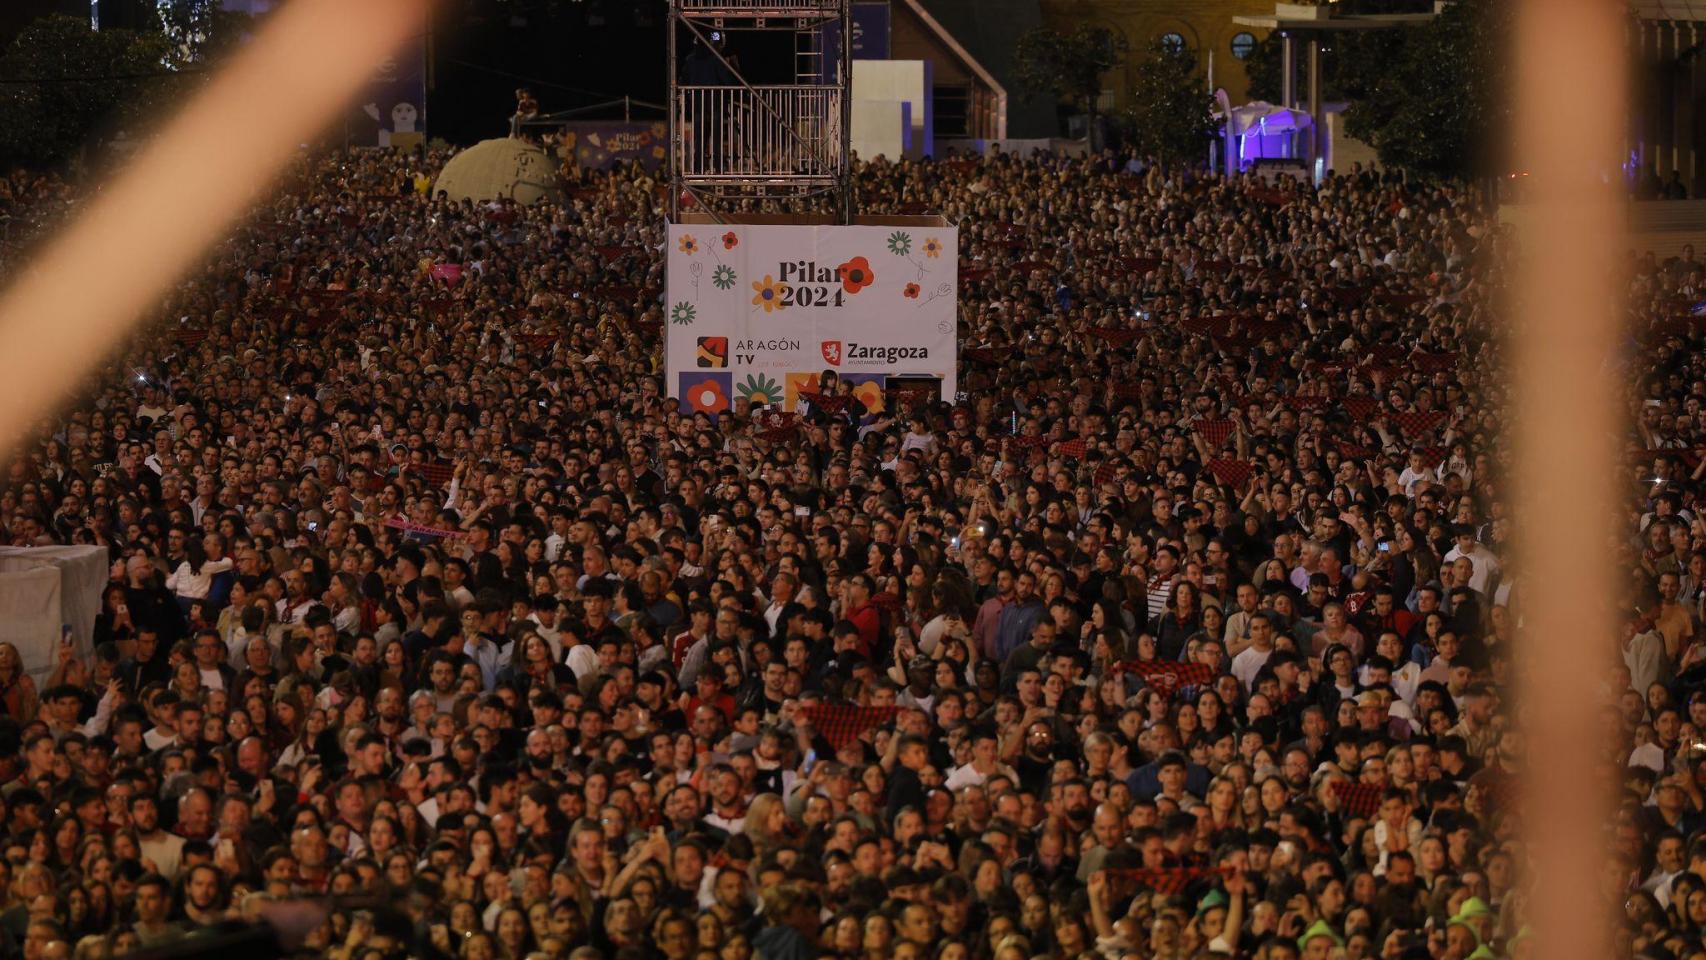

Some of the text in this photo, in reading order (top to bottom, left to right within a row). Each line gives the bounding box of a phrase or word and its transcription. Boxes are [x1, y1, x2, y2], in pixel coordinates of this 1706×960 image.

[779, 260, 848, 283] Pilar
[779, 286, 846, 307] 2024
[735, 337, 801, 351] ARAGÓN
[847, 343, 928, 364] Zaragoza
[736, 354, 755, 365] TV
